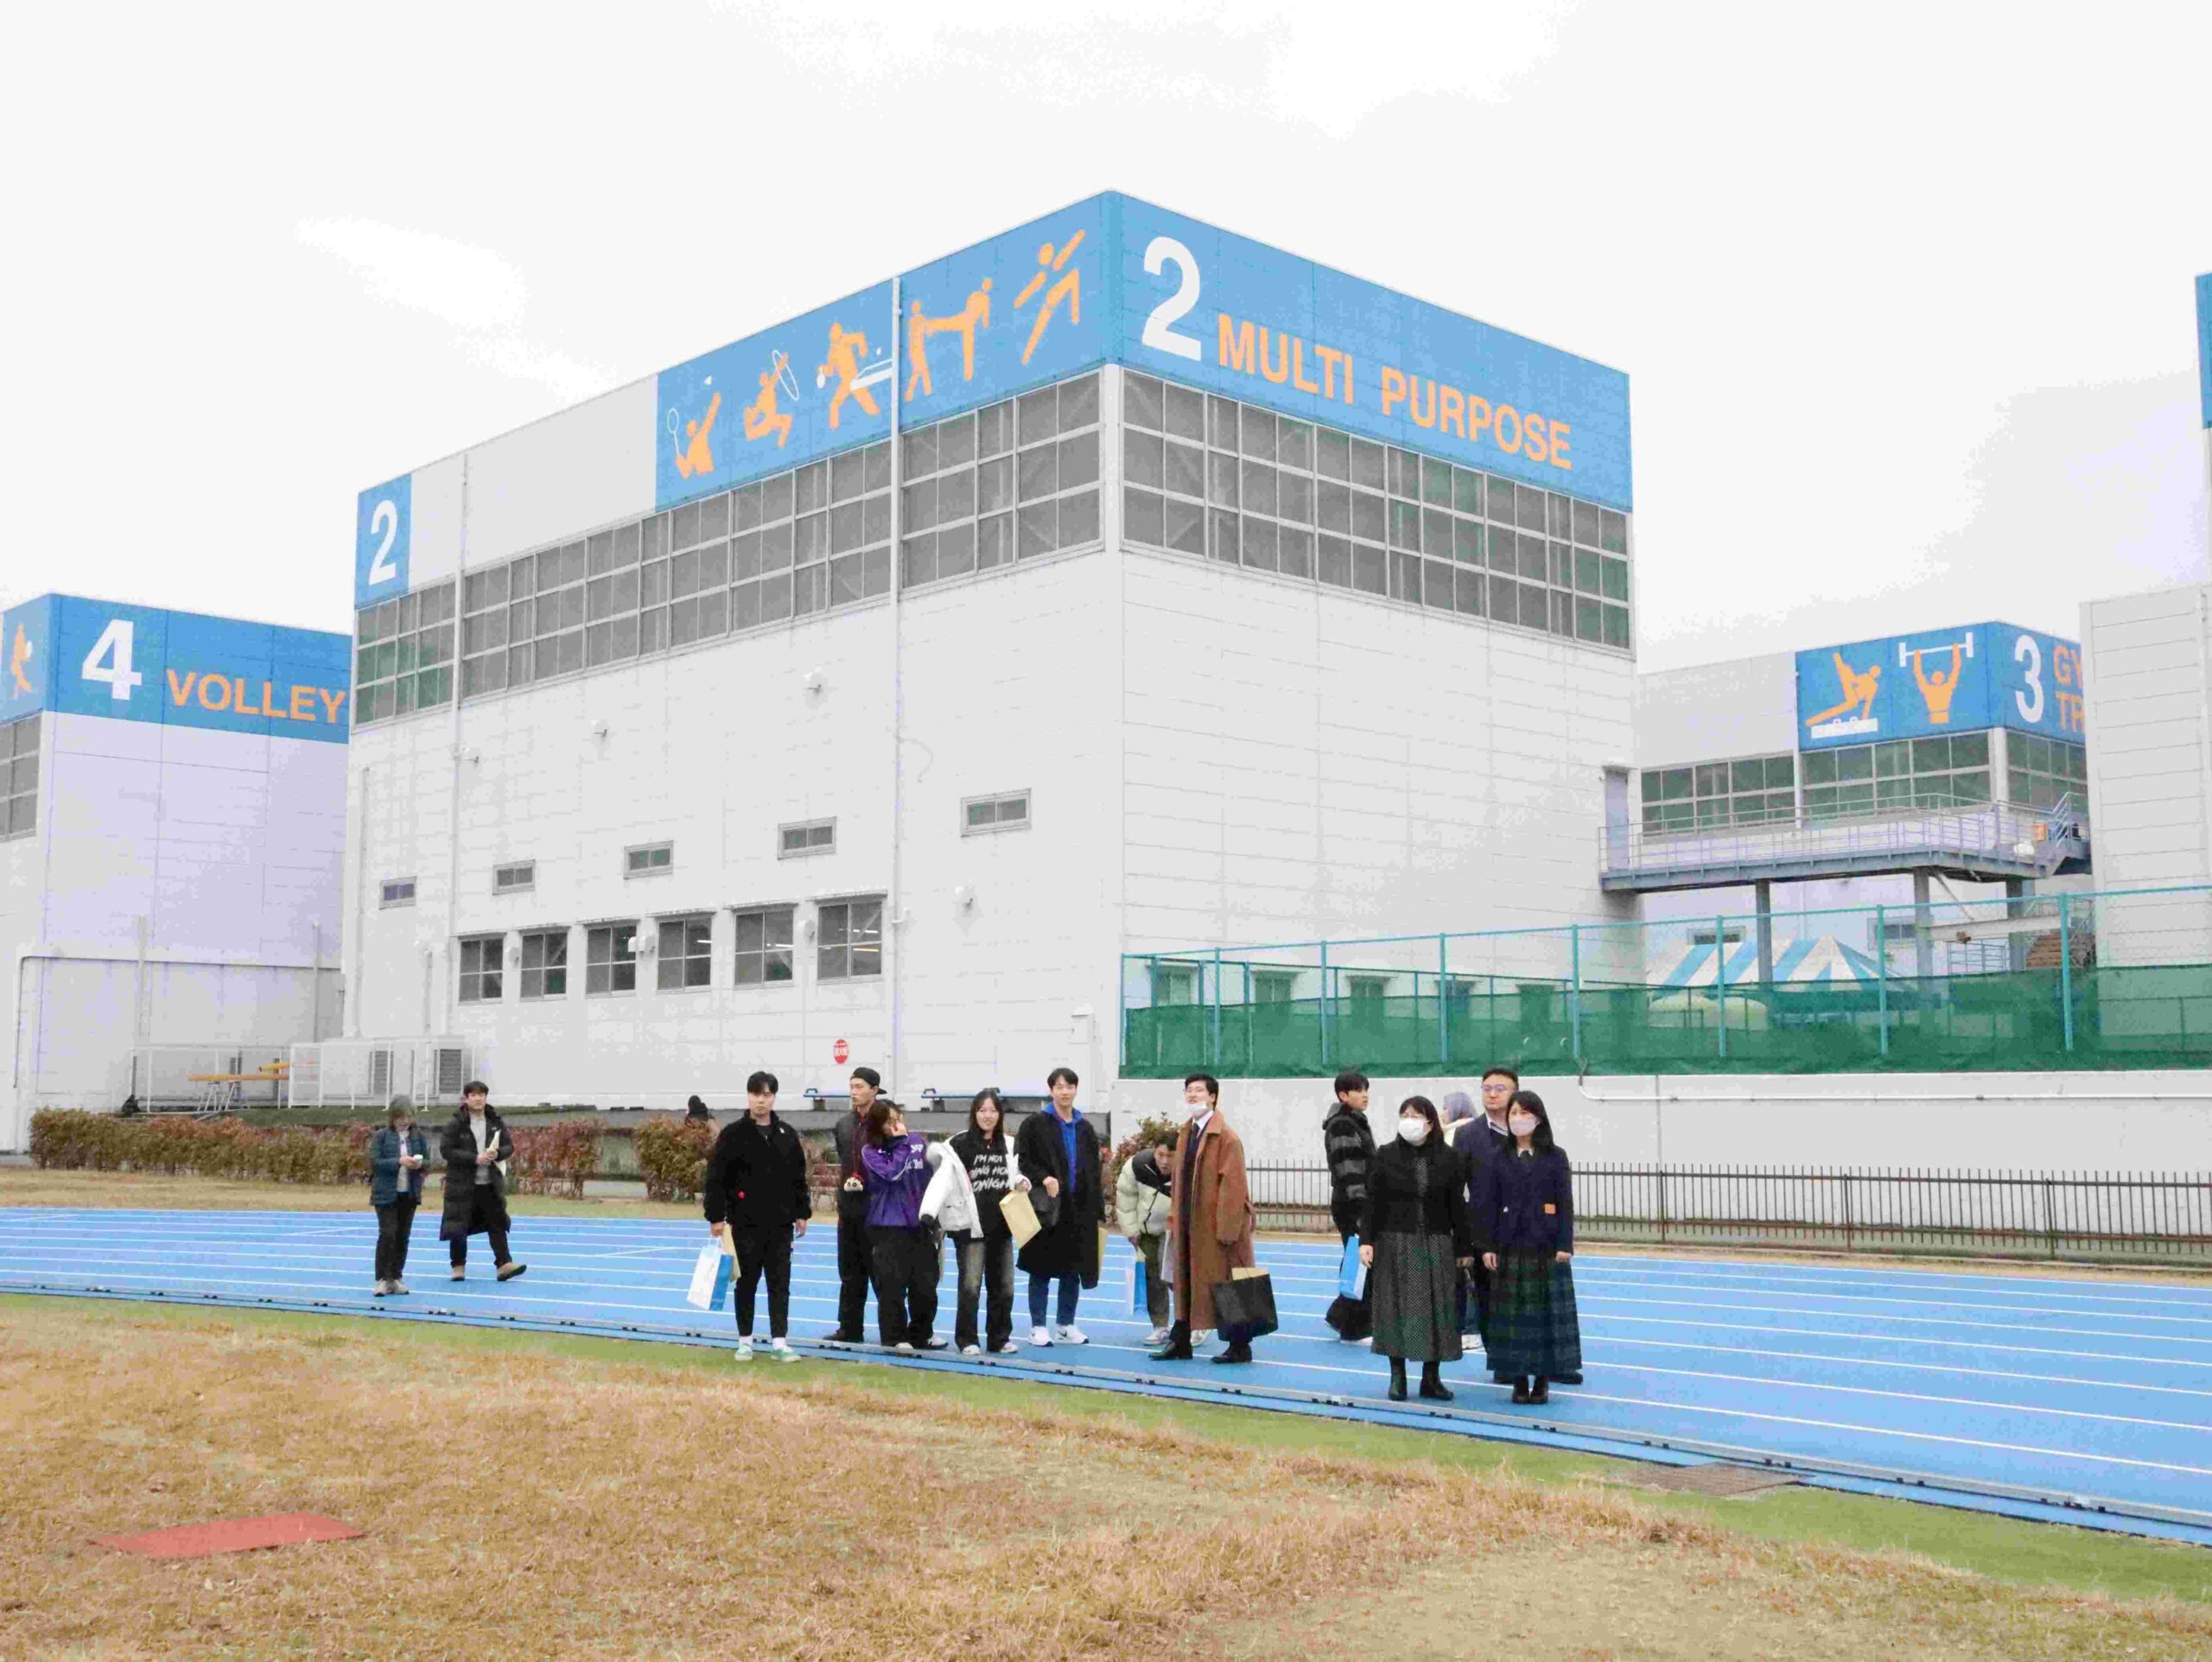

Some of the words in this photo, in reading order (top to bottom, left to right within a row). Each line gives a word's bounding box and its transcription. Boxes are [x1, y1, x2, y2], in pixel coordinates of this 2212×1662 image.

[1141, 236, 1202, 361] 2
[1218, 313, 1353, 404] MULTI
[1381, 365, 1573, 470] PURPOSE
[368, 499, 397, 586] 2
[81, 618, 143, 701] 4
[167, 668, 345, 724] VOLLEY
[2014, 634, 2044, 723] 3
